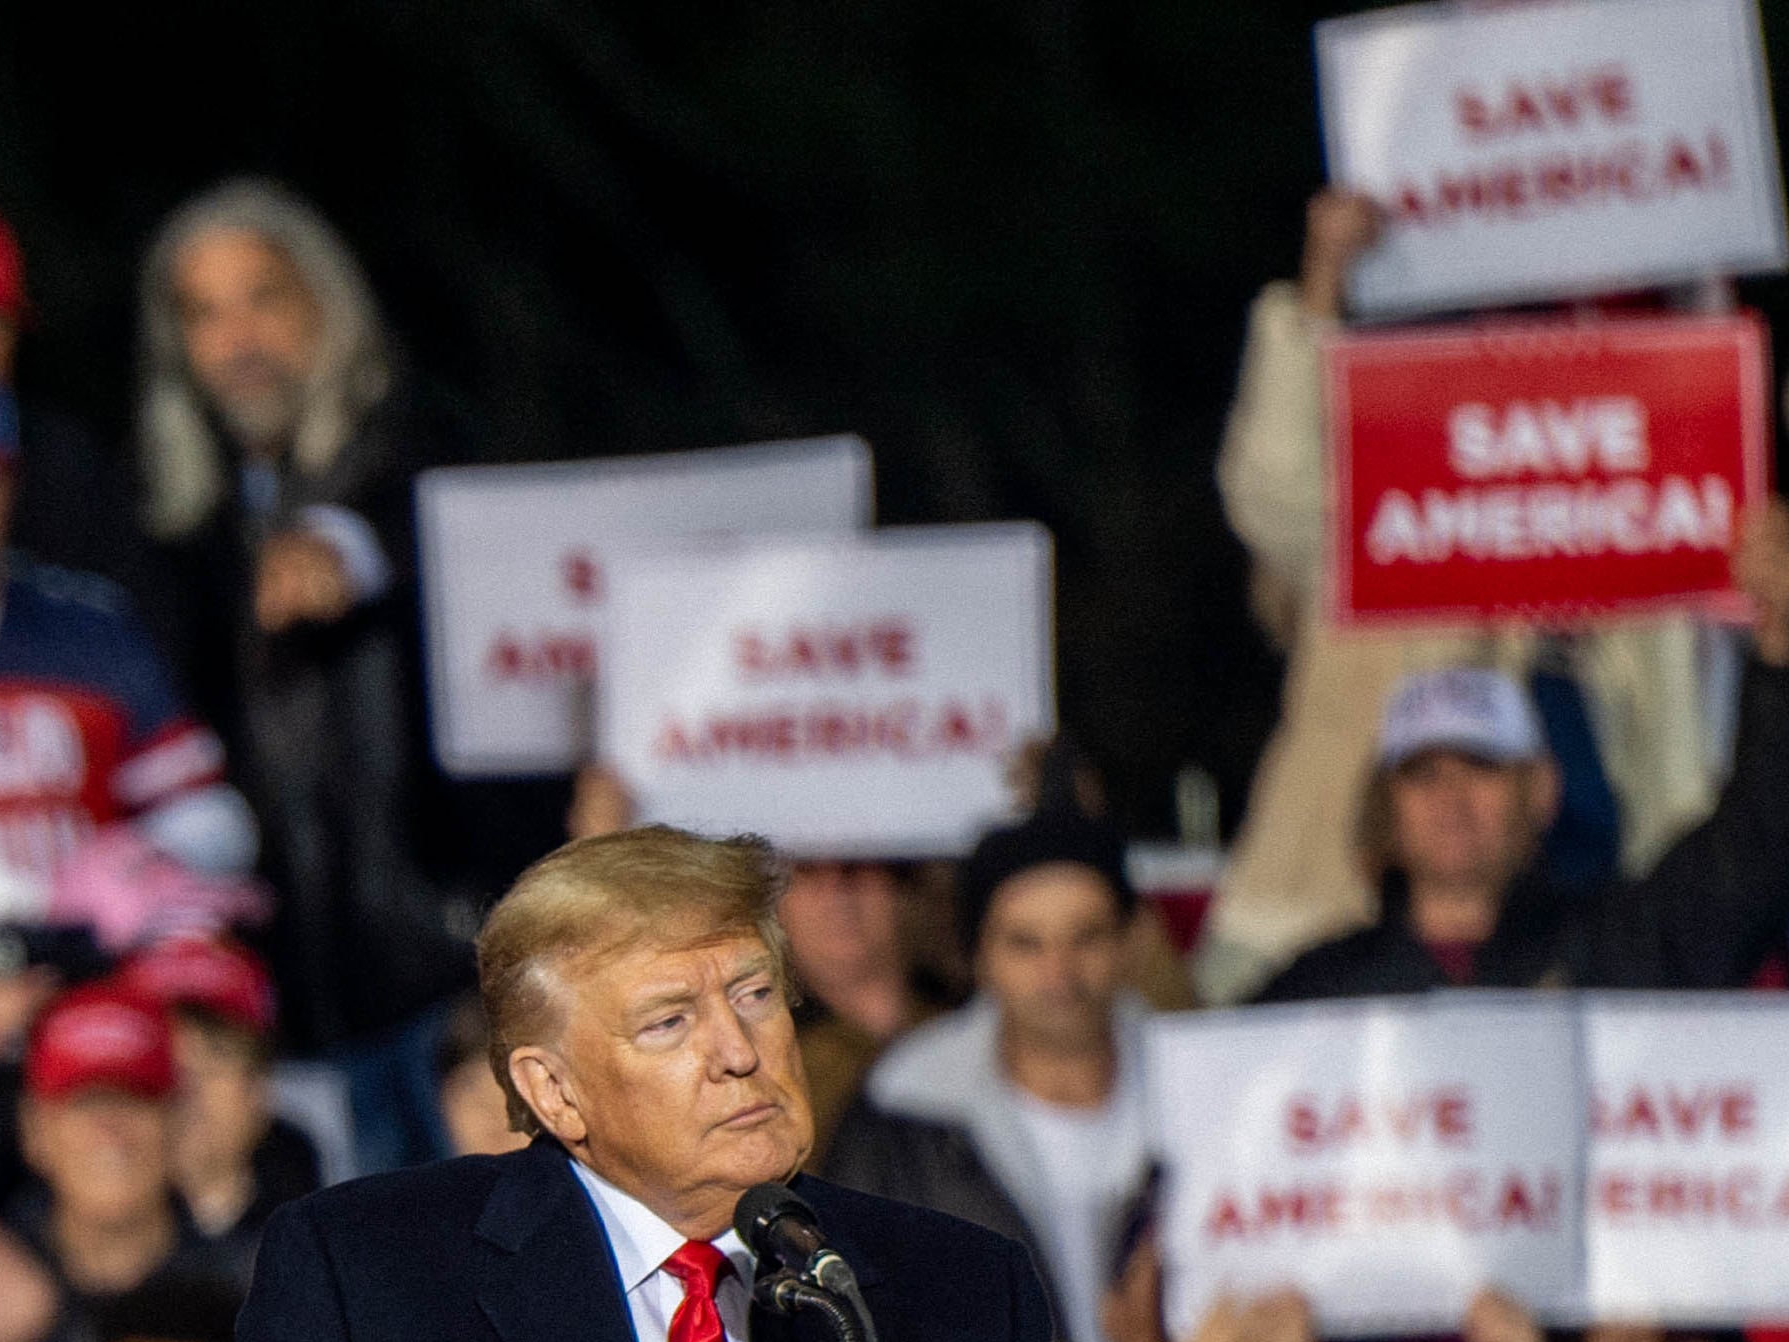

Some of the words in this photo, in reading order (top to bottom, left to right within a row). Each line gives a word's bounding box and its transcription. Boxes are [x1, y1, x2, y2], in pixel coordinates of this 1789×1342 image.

[1456, 65, 1629, 143] SAVE
[1449, 398, 1646, 476] SAVE
[1368, 477, 1732, 564] AMERICA!
[731, 612, 918, 682] SAVE
[1284, 1085, 1472, 1154] SAVE
